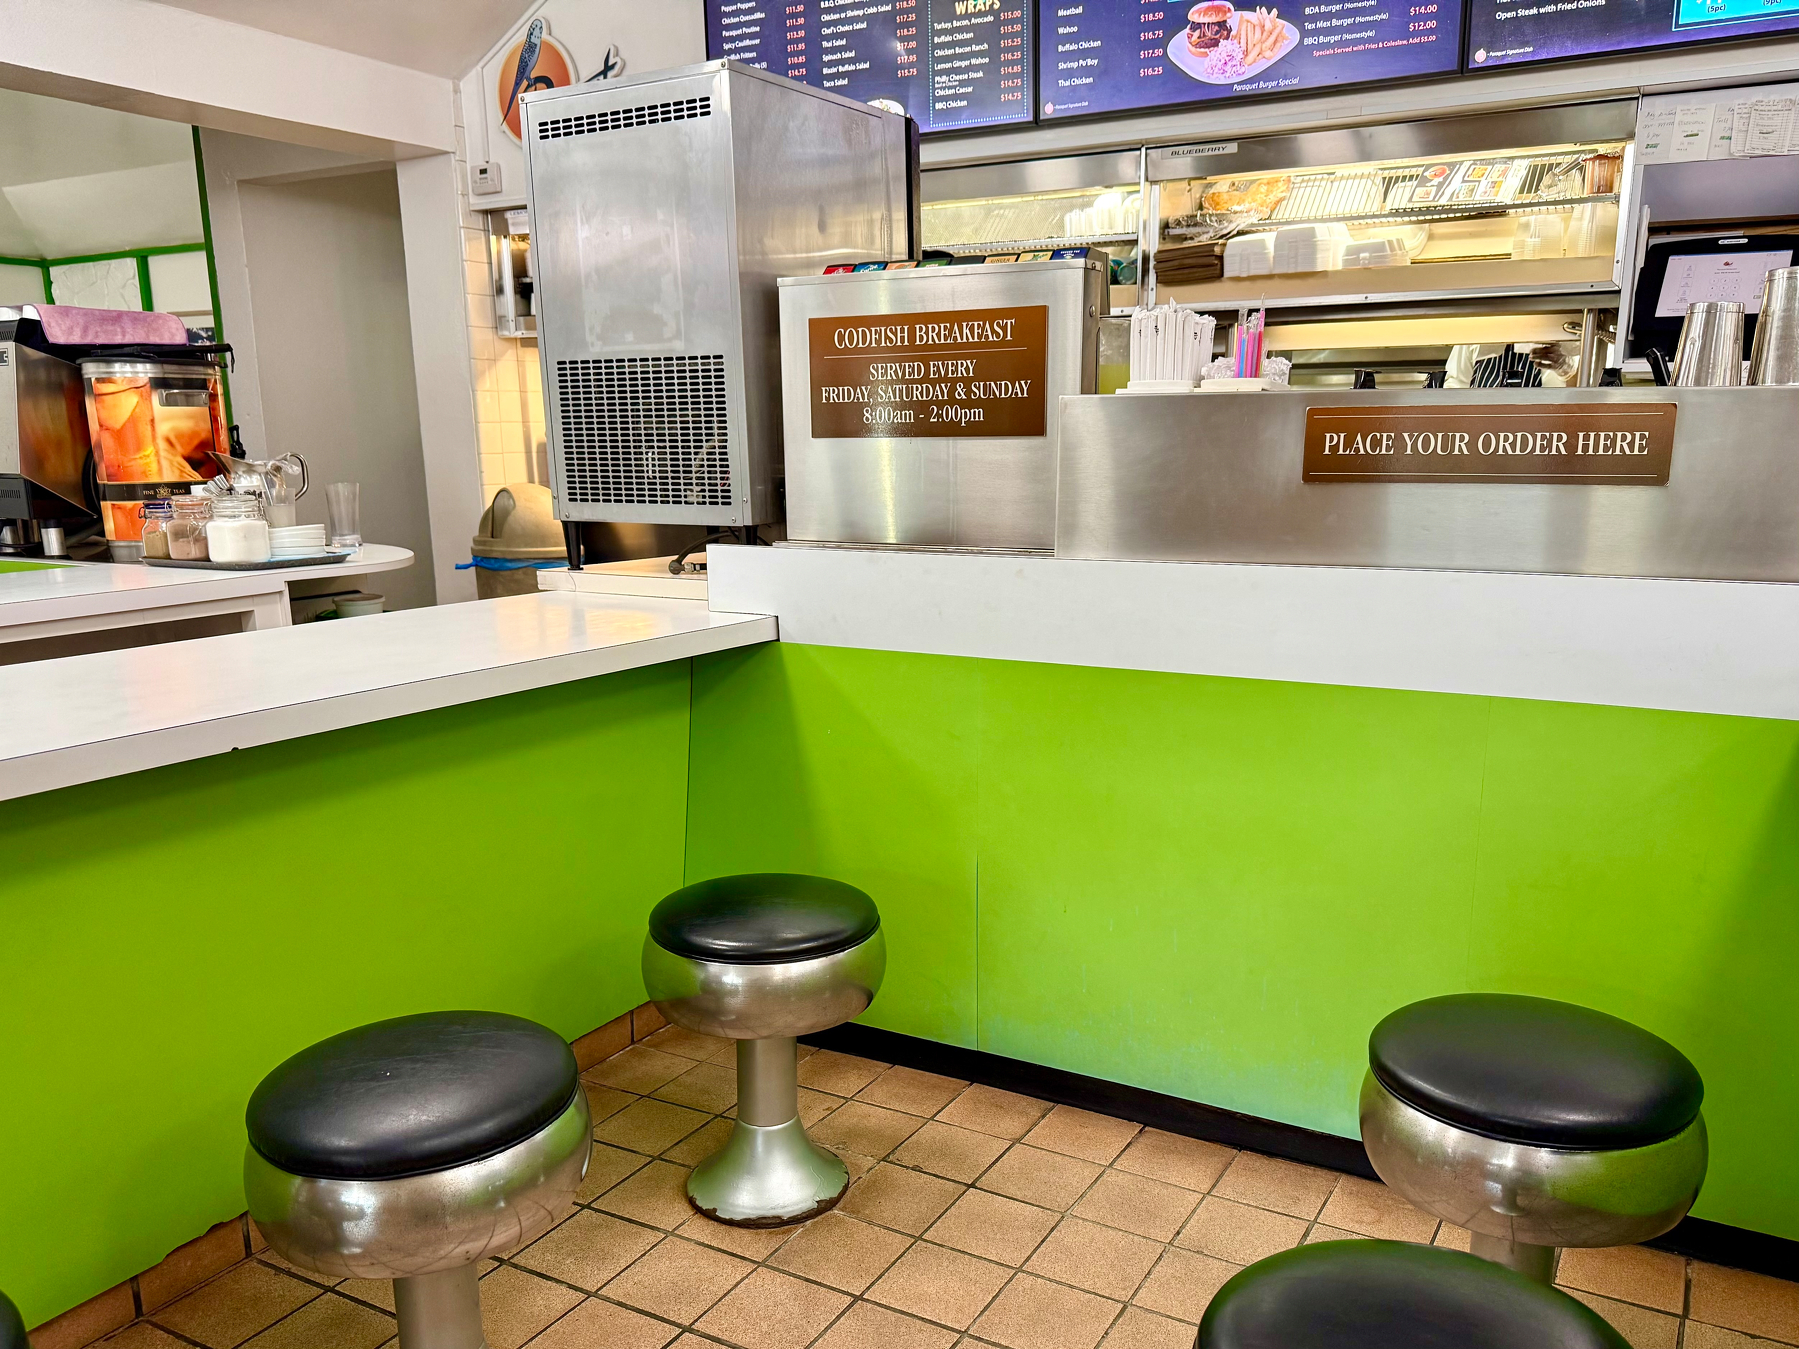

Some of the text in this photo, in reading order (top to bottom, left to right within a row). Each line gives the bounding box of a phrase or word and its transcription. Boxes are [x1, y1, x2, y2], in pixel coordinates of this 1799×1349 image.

[786, 5, 804, 14] $11.50
[821, 12, 840, 21] Chicken
[846, 8, 864, 18] Shrimp
[864, 6, 878, 14] Cobb
[878, 4, 892, 12] Salad
[955, 0, 1000, 15] WRAPS
[1058, 6, 1083, 17] Meatball
[1304, 0, 1377, 15] BDA Burger (Homestyle)
[1410, 4, 1437, 16] $14.00
[1495, 0, 1605, 20] Open Steak with Fried Onions
[1708, 4, 1726, 13] (5pc)
[722, 12, 766, 25] Chicken Quesadillas
[896, 14, 916, 23] $17.25
[1000, 10, 1021, 20] $15.00
[1140, 12, 1164, 22] $18.50
[786, 18, 805, 27] $11.50
[837, 24, 853, 32] Choice
[853, 21, 867, 30] Salad
[953, 19, 970, 27] Bacon,
[971, 15, 994, 24] Avocado
[1304, 13, 1389, 30] Tex Mex Burger (Homestyle)
[1409, 20, 1436, 31] $12.00
[786, 30, 805, 39] $13.50
[896, 27, 916, 37] $18.25
[1000, 24, 1022, 34] $15.50
[1058, 26, 1078, 34] Wahoo
[934, 32, 974, 43] Buffalo Chicken
[1140, 30, 1163, 40] $16.75
[1304, 30, 1376, 45] BBQ Burger (Homestyle)
[723, 42, 735, 50] Spicy
[822, 38, 846, 48] Thai Salad
[897, 41, 916, 50] $17.00
[1000, 38, 1022, 47] $15.25
[1058, 40, 1101, 52] Buffalo Chicken
[1312, 49, 1334, 57] Specials
[1365, 42, 1378, 50] Fries
[1384, 39, 1408, 48] Coleslaw,
[934, 43, 988, 57] Chicken Bacon Ranch
[1140, 48, 1163, 59] $17.50
[822, 50, 855, 62] Spinach Salad
[1000, 52, 1022, 61] $16.25
[839, 64, 856, 72] Buffalo
[856, 61, 870, 69] Salad
[953, 60, 970, 68] Ginger
[971, 56, 989, 65] Wahoo
[1058, 61, 1078, 70] Shrimp
[788, 68, 806, 77] $14.75
[898, 68, 917, 78] $15.75
[1001, 65, 1022, 75] $14.85
[1140, 67, 1162, 77] $16.25
[935, 70, 983, 83] Philly Cheese Steak
[1071, 76, 1094, 86] Chicken
[823, 78, 848, 88] Taco Salad
[1001, 79, 1022, 88] $14.75
[1233, 76, 1299, 91] Paraquet Burger Special
[935, 86, 973, 97] Chicken Caesar
[1001, 92, 1022, 102] $14.75
[935, 100, 968, 110] BBQ Chicken
[1171, 146, 1227, 156] BLUEBERRY
[834, 318, 1016, 348] CODFISH BREAKFAST
[869, 360, 976, 380] SERVED EVERY
[821, 380, 1031, 404] FRIDAY, SATURDAY & SUNDAY
[863, 406, 914, 424] 8:00am
[929, 405, 984, 426] 2:00pm
[1323, 431, 1649, 456] PLACE YOUR ORDER HERE
